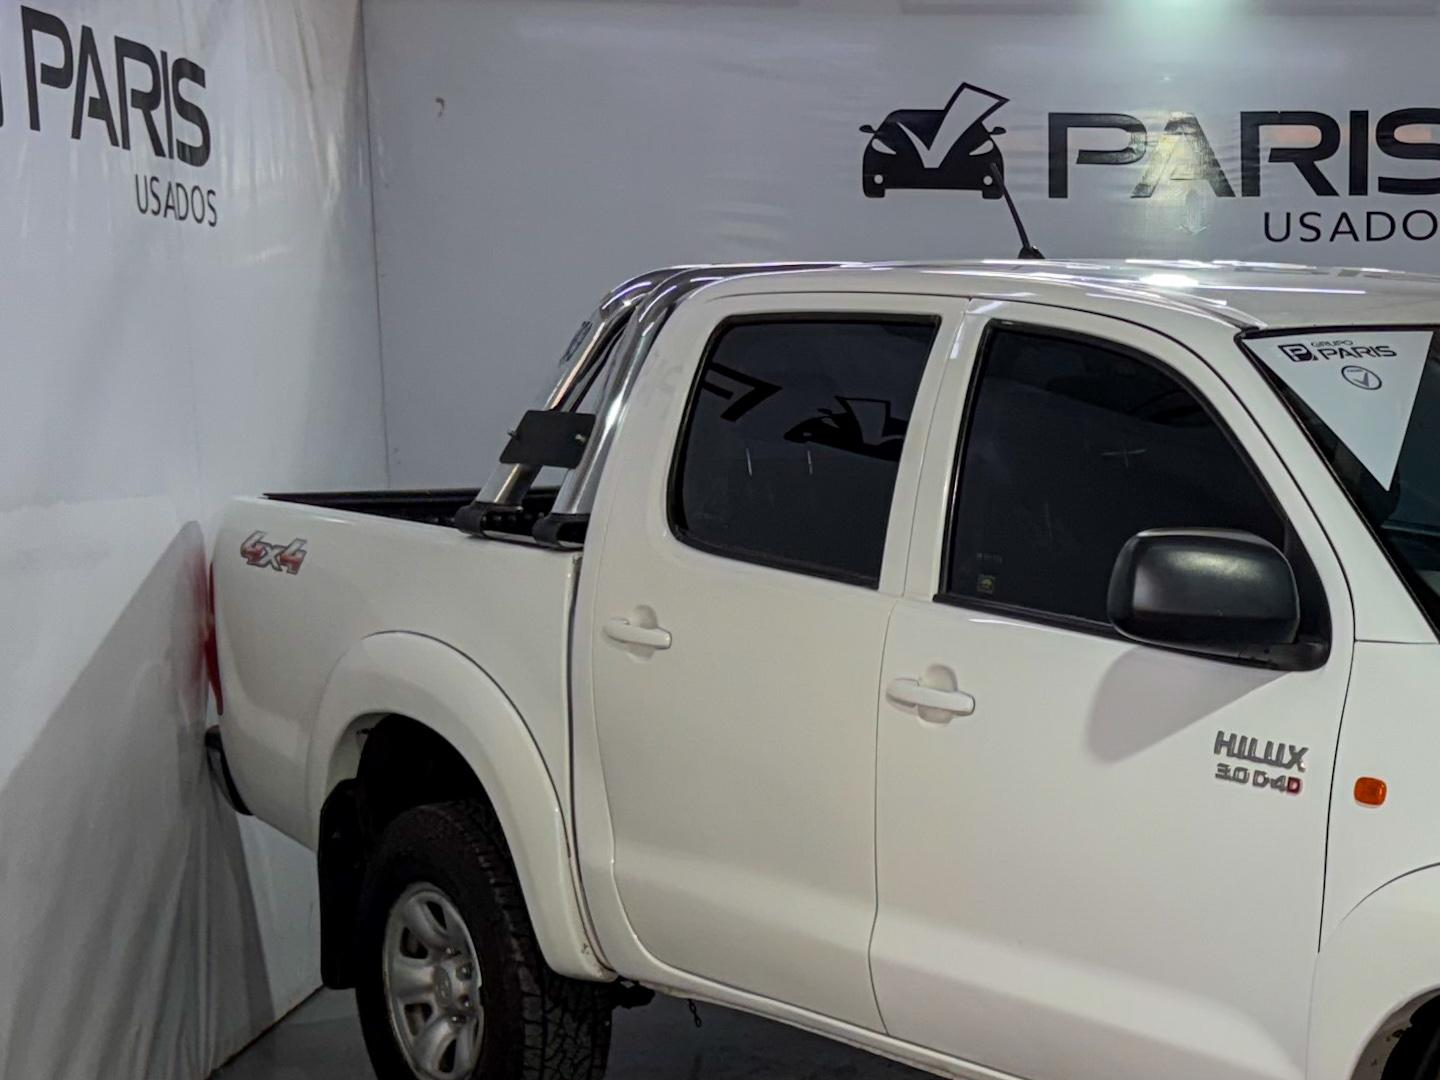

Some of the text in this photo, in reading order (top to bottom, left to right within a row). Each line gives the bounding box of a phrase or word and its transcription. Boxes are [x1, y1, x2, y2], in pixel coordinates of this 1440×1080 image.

[20, 4, 212, 168] PARIS
[134, 173, 218, 228] USADOS
[1311, 340, 1354, 348] GRUPO
[1317, 345, 1397, 360] PARIS
[1213, 730, 1309, 773] HILUX
